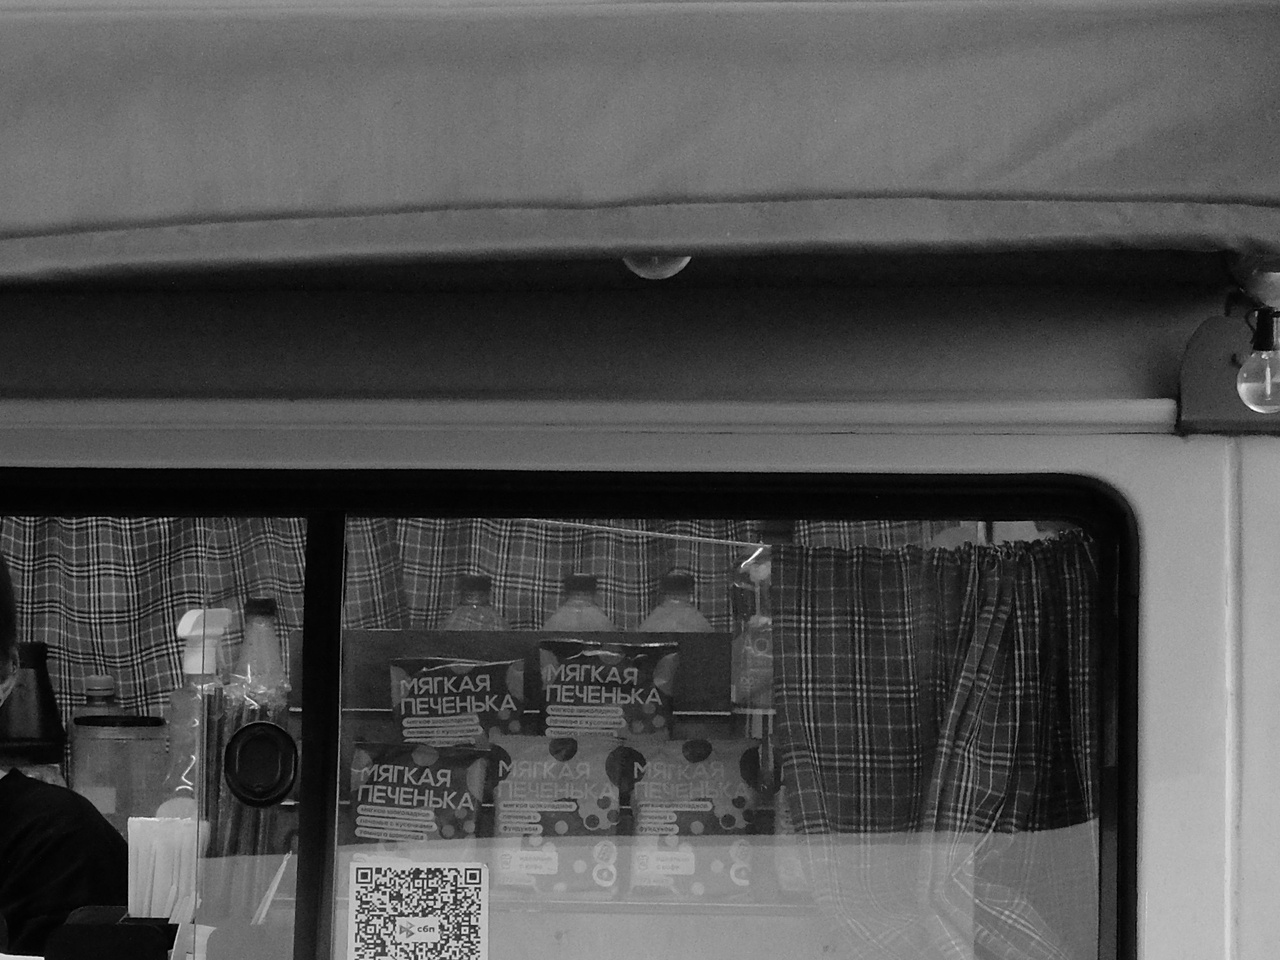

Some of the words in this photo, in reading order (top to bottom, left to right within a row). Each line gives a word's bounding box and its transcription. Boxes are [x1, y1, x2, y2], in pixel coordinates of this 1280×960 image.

[400, 674, 491, 695] МЯГКАЯ
[542, 663, 639, 686] МЯГКАЯ
[400, 693, 518, 716] ПЕЧЕНЬКА
[545, 684, 663, 706] ПЕЧЕНЬКА
[361, 764, 452, 788] МЯГКАЯ
[498, 760, 591, 780] МЯГКАЯ
[357, 784, 475, 812] ПЕЧЕНЬКА
[498, 780, 617, 801] ПЕЧЕНЬКА
[417, 925, 435, 933] сбп
